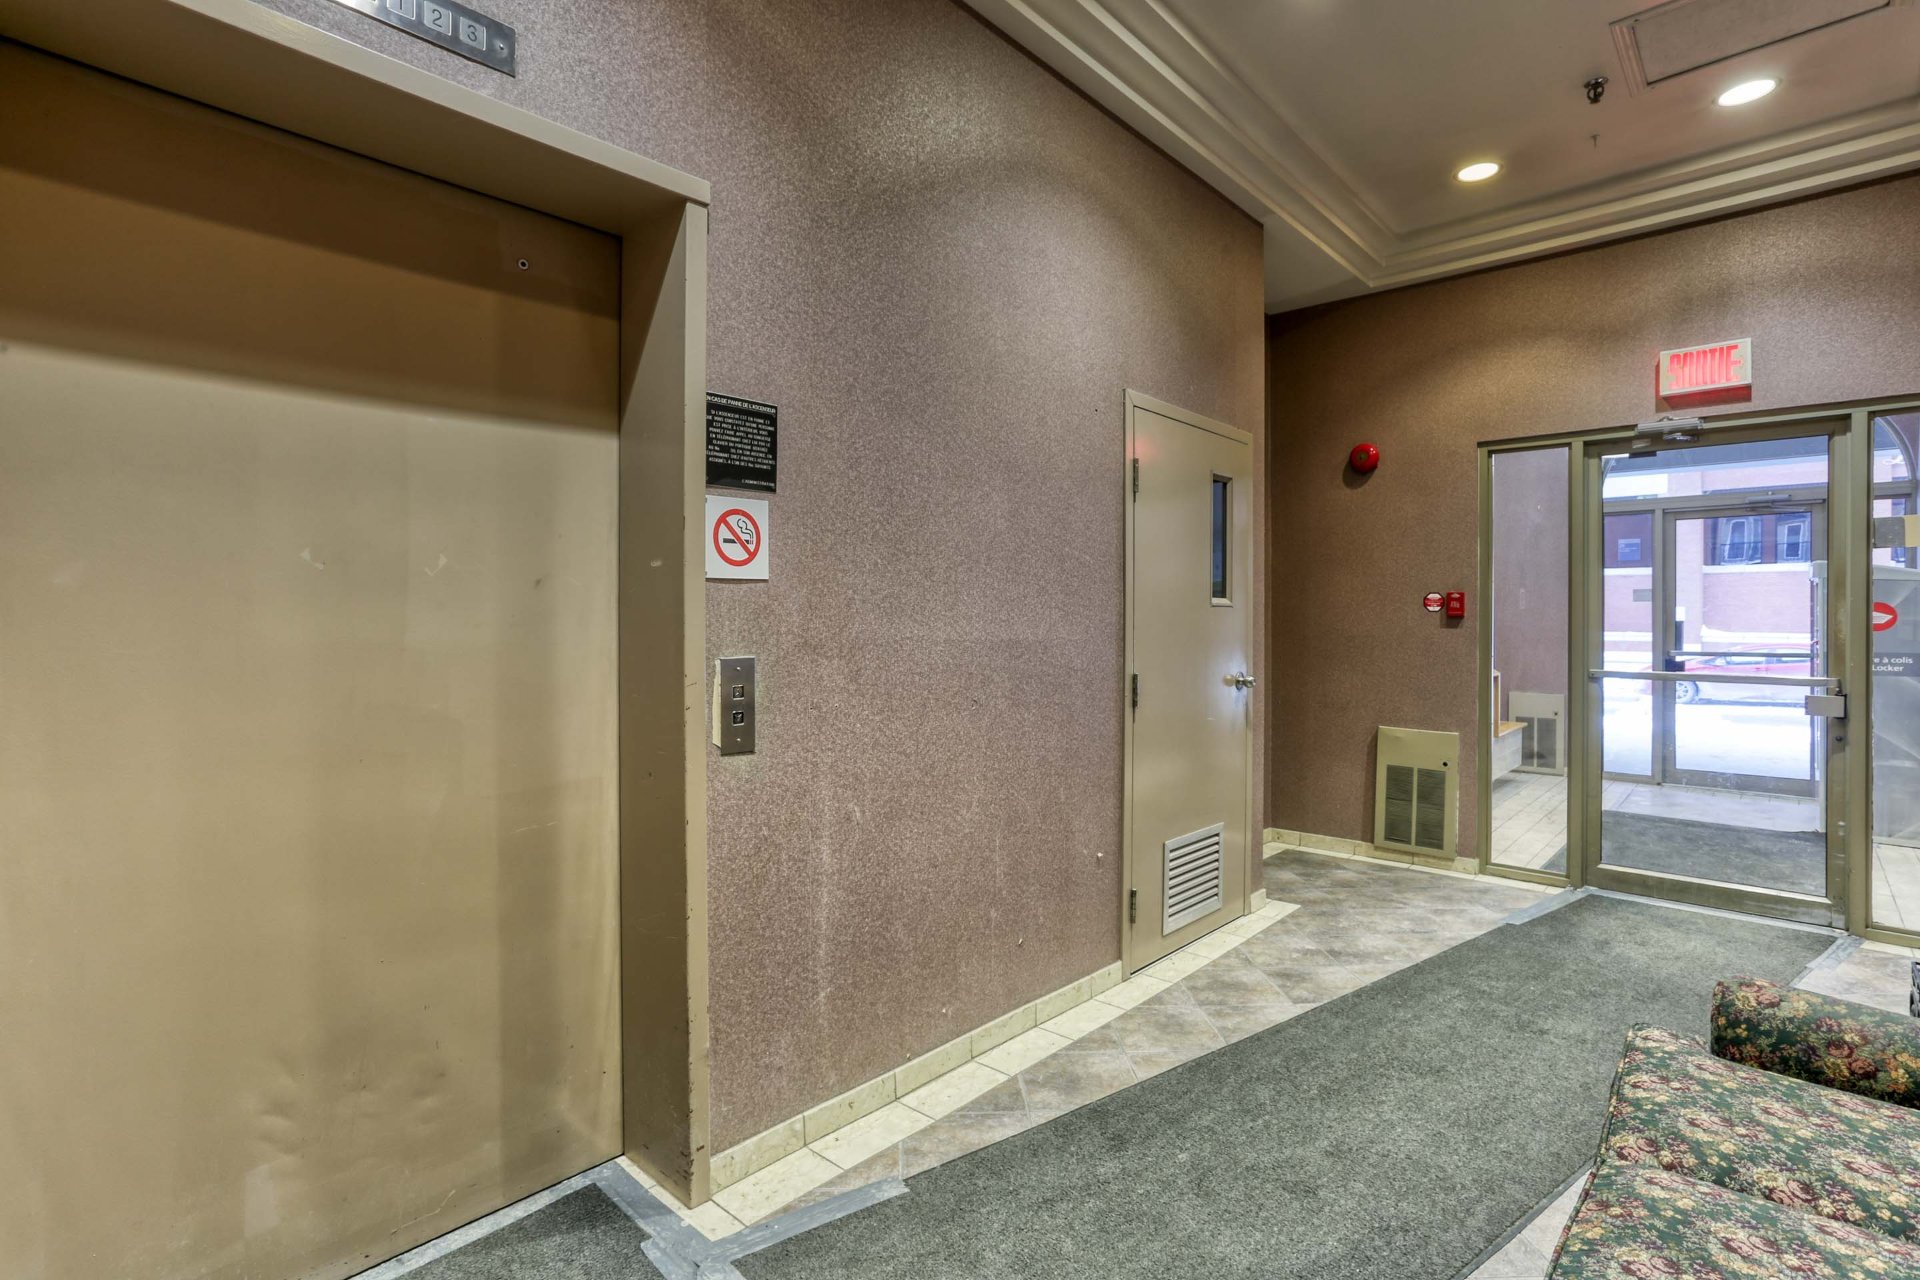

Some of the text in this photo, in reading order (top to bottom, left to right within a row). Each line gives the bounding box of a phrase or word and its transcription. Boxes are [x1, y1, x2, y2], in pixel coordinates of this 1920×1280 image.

[431, 8, 443, 28] 2
[467, 24, 478, 43] 3
[1668, 343, 1742, 390] SORTIE
[1872, 664, 1905, 672] Locker
[1882, 656, 1889, 664] à
[1890, 656, 1913, 664] colis
